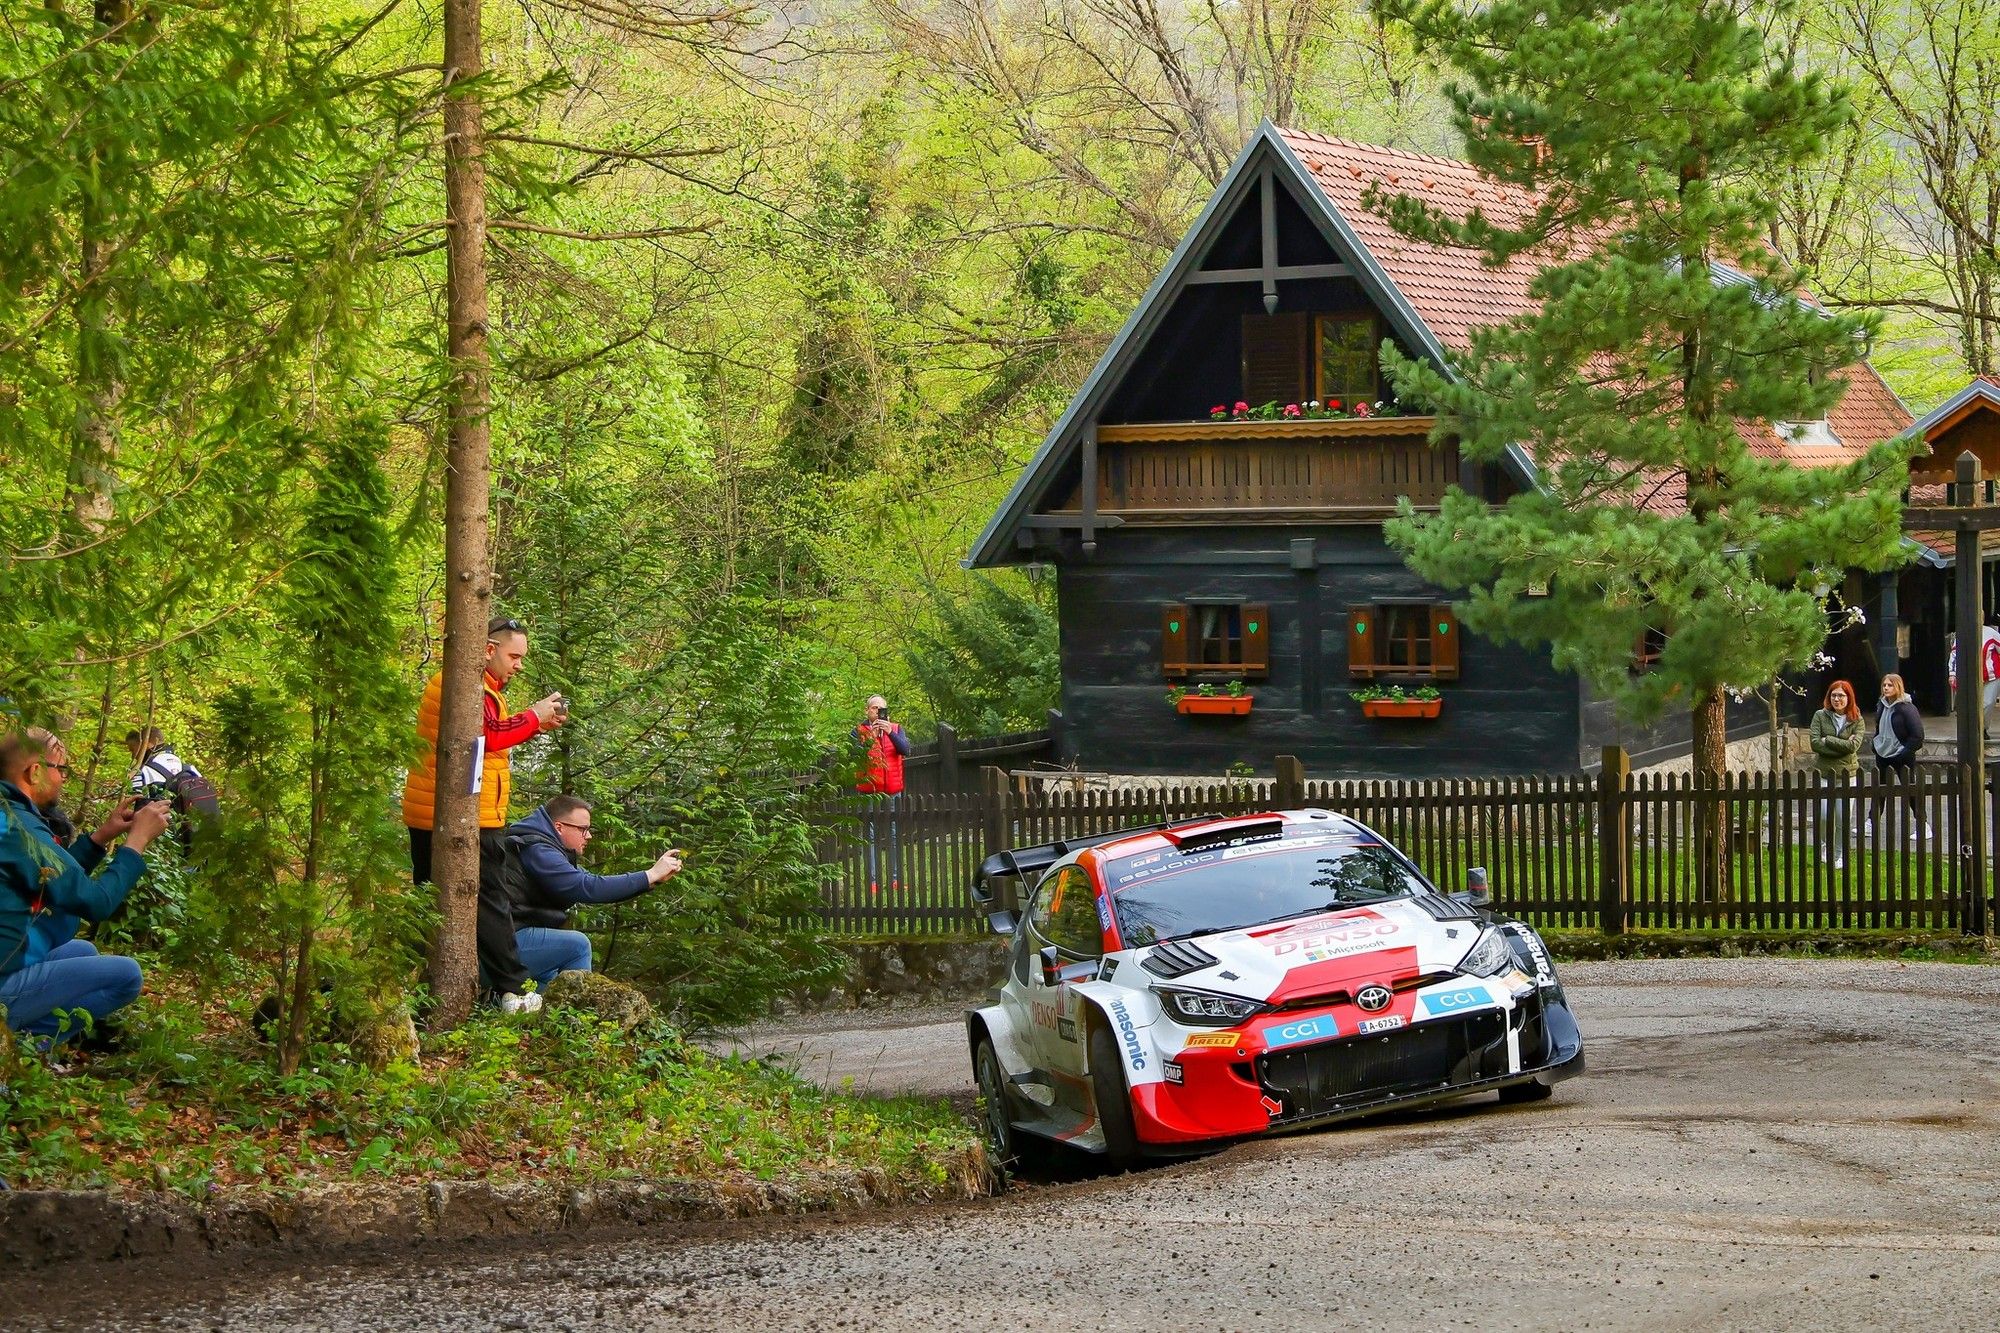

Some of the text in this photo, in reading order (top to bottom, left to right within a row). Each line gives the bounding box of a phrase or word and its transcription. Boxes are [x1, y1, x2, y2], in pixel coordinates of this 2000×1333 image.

[1165, 841, 1227, 858] TOYOTA
[1230, 832, 1285, 847] GAZOO
[1119, 854, 1214, 884] BEYOND
[1274, 924, 1399, 957] DENSO
[1328, 940, 1387, 956] Microsoft
[1032, 1000, 1057, 1031] DENSO
[1369, 1017, 1399, 1032] A-6752
[1186, 1033, 1235, 1046] PIRELLI
[1164, 1066, 1183, 1081] OMP
